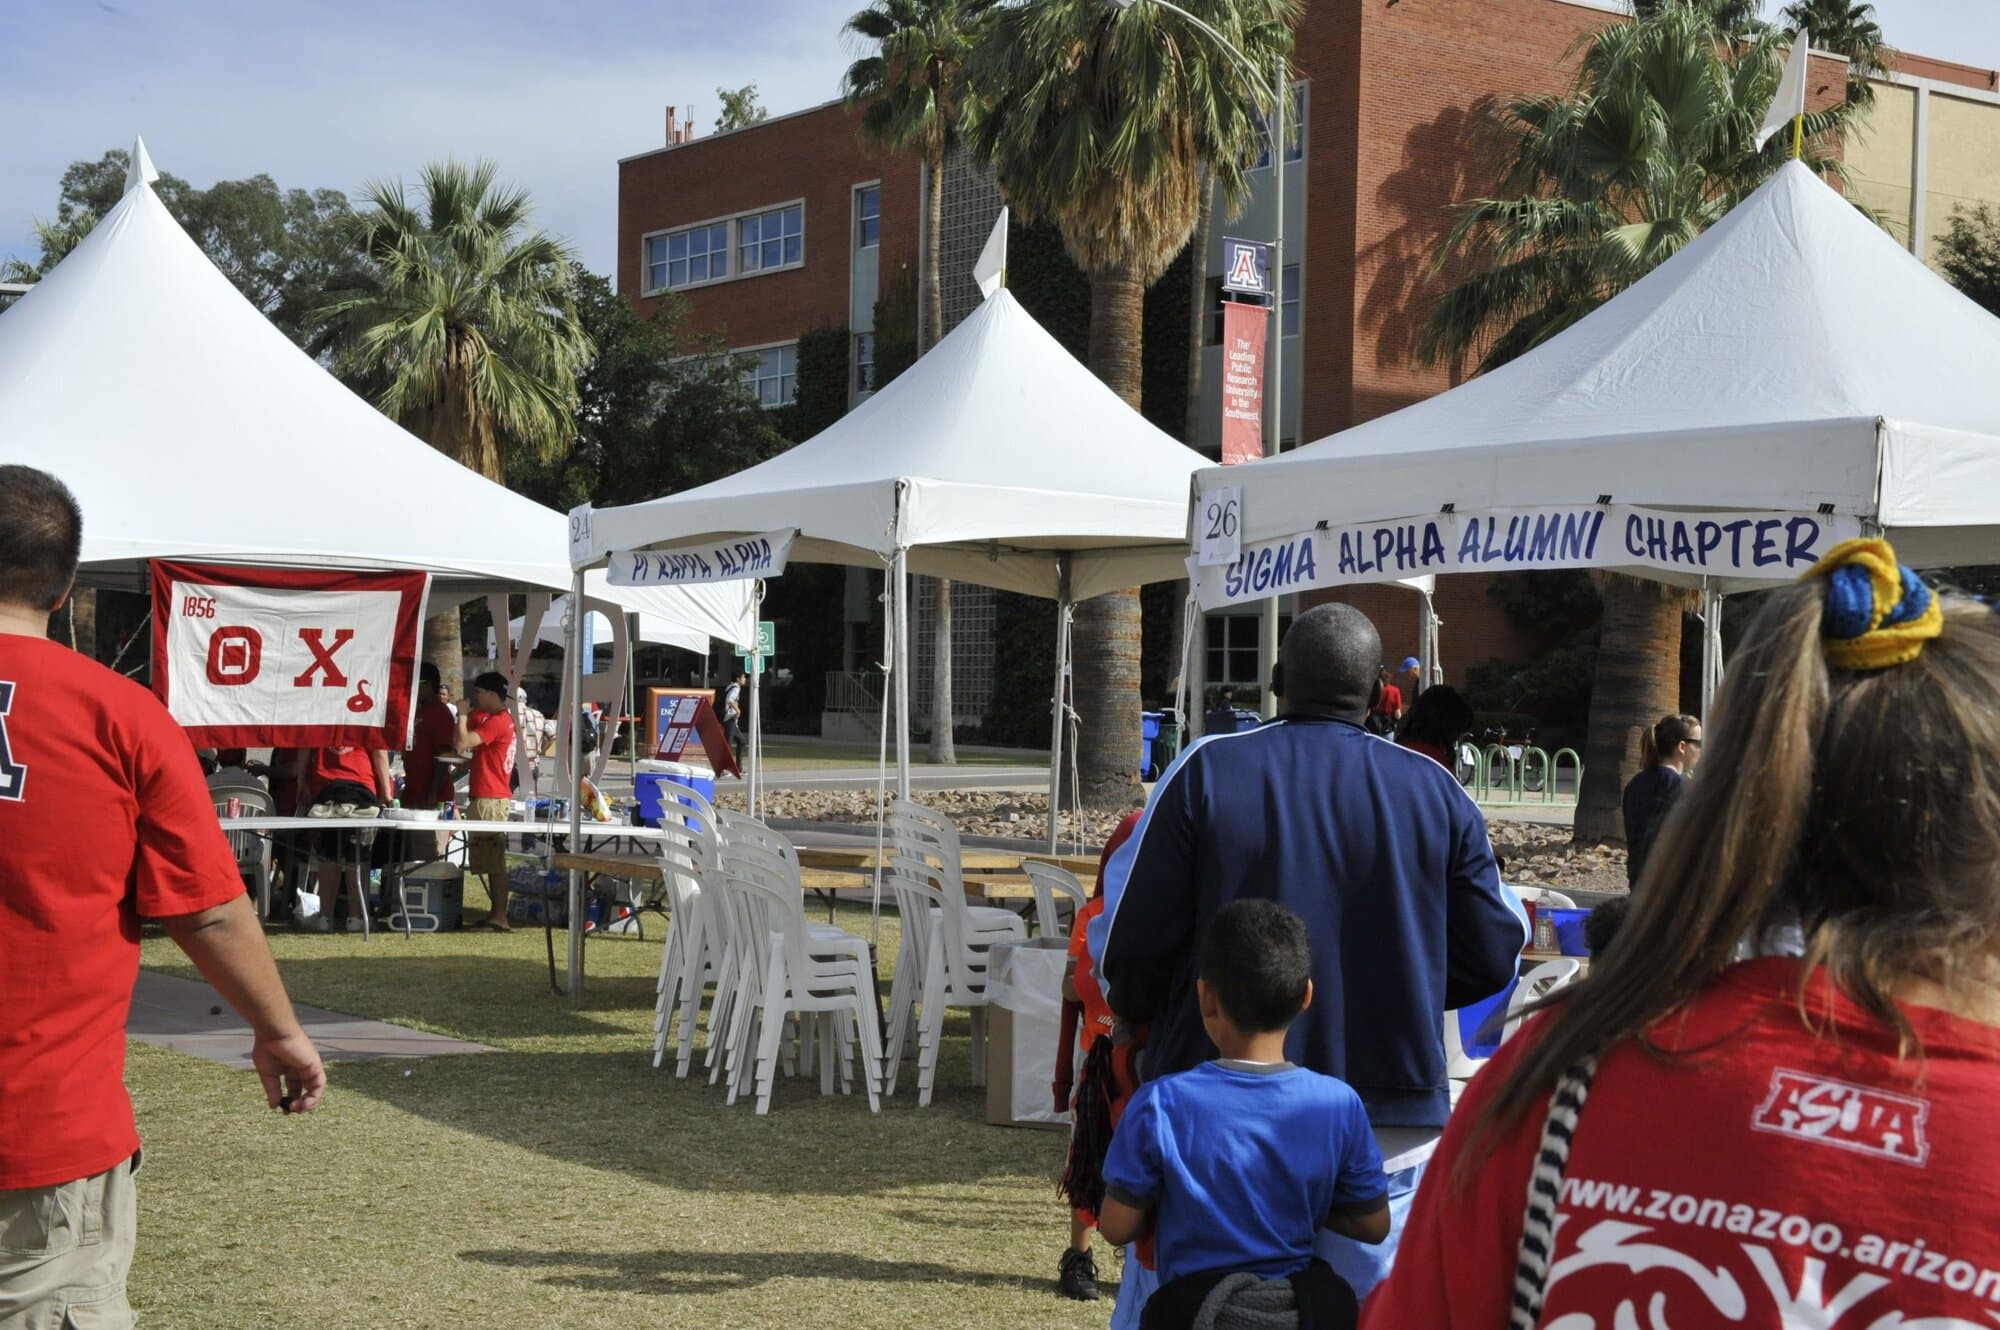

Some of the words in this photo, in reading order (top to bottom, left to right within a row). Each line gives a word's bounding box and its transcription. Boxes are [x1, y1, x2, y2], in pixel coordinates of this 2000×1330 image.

[1227, 244, 1263, 288] A
[1236, 339, 1250, 350] The
[1229, 350, 1256, 365] Leading
[1231, 361, 1252, 374] Public
[1226, 372, 1258, 386] Research
[1225, 384, 1258, 399] University
[571, 512, 590, 544] 24
[1206, 500, 1237, 540] 26
[632, 553, 648, 582] PI
[657, 552, 712, 580] KAPPA
[714, 538, 772, 577] ALPHA
[1225, 536, 1316, 598] SIGMA
[1338, 520, 1446, 575] ALPHA
[1458, 510, 1604, 563] ALUMNI
[1625, 513, 1821, 569] CHAPTER
[182, 596, 216, 619] 1856
